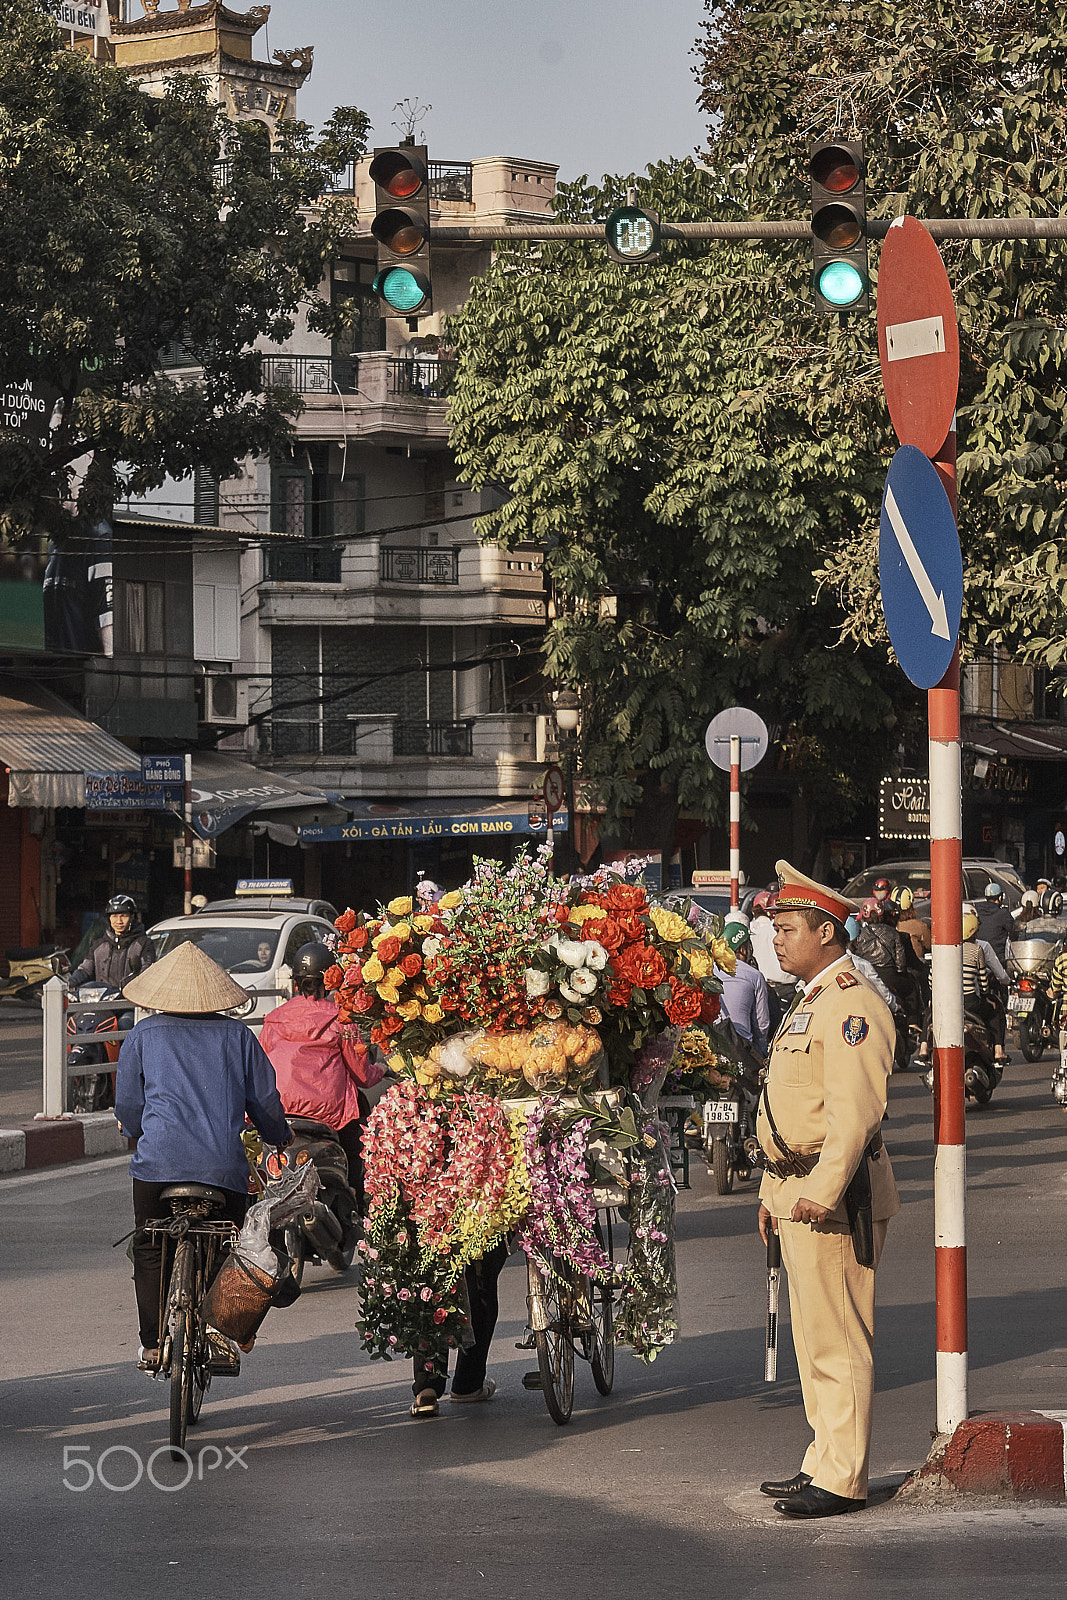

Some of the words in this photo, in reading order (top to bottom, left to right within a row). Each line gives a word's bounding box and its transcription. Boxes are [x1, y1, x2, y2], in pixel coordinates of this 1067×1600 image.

[616, 217, 651, 250] 08
[8, 394, 46, 412] DƯỠNG
[155, 759, 171, 767] PHỐ
[891, 785, 927, 811] Hoài
[302, 827, 324, 837] pepsi
[342, 825, 362, 838] XÔI
[371, 824, 389, 837] GÀ
[422, 820, 442, 835] LẨU
[451, 822, 478, 834] CƠM
[481, 821, 513, 832] RANG
[731, 929, 746, 944] Grab
[706, 1112, 736, 1121] 198.51
